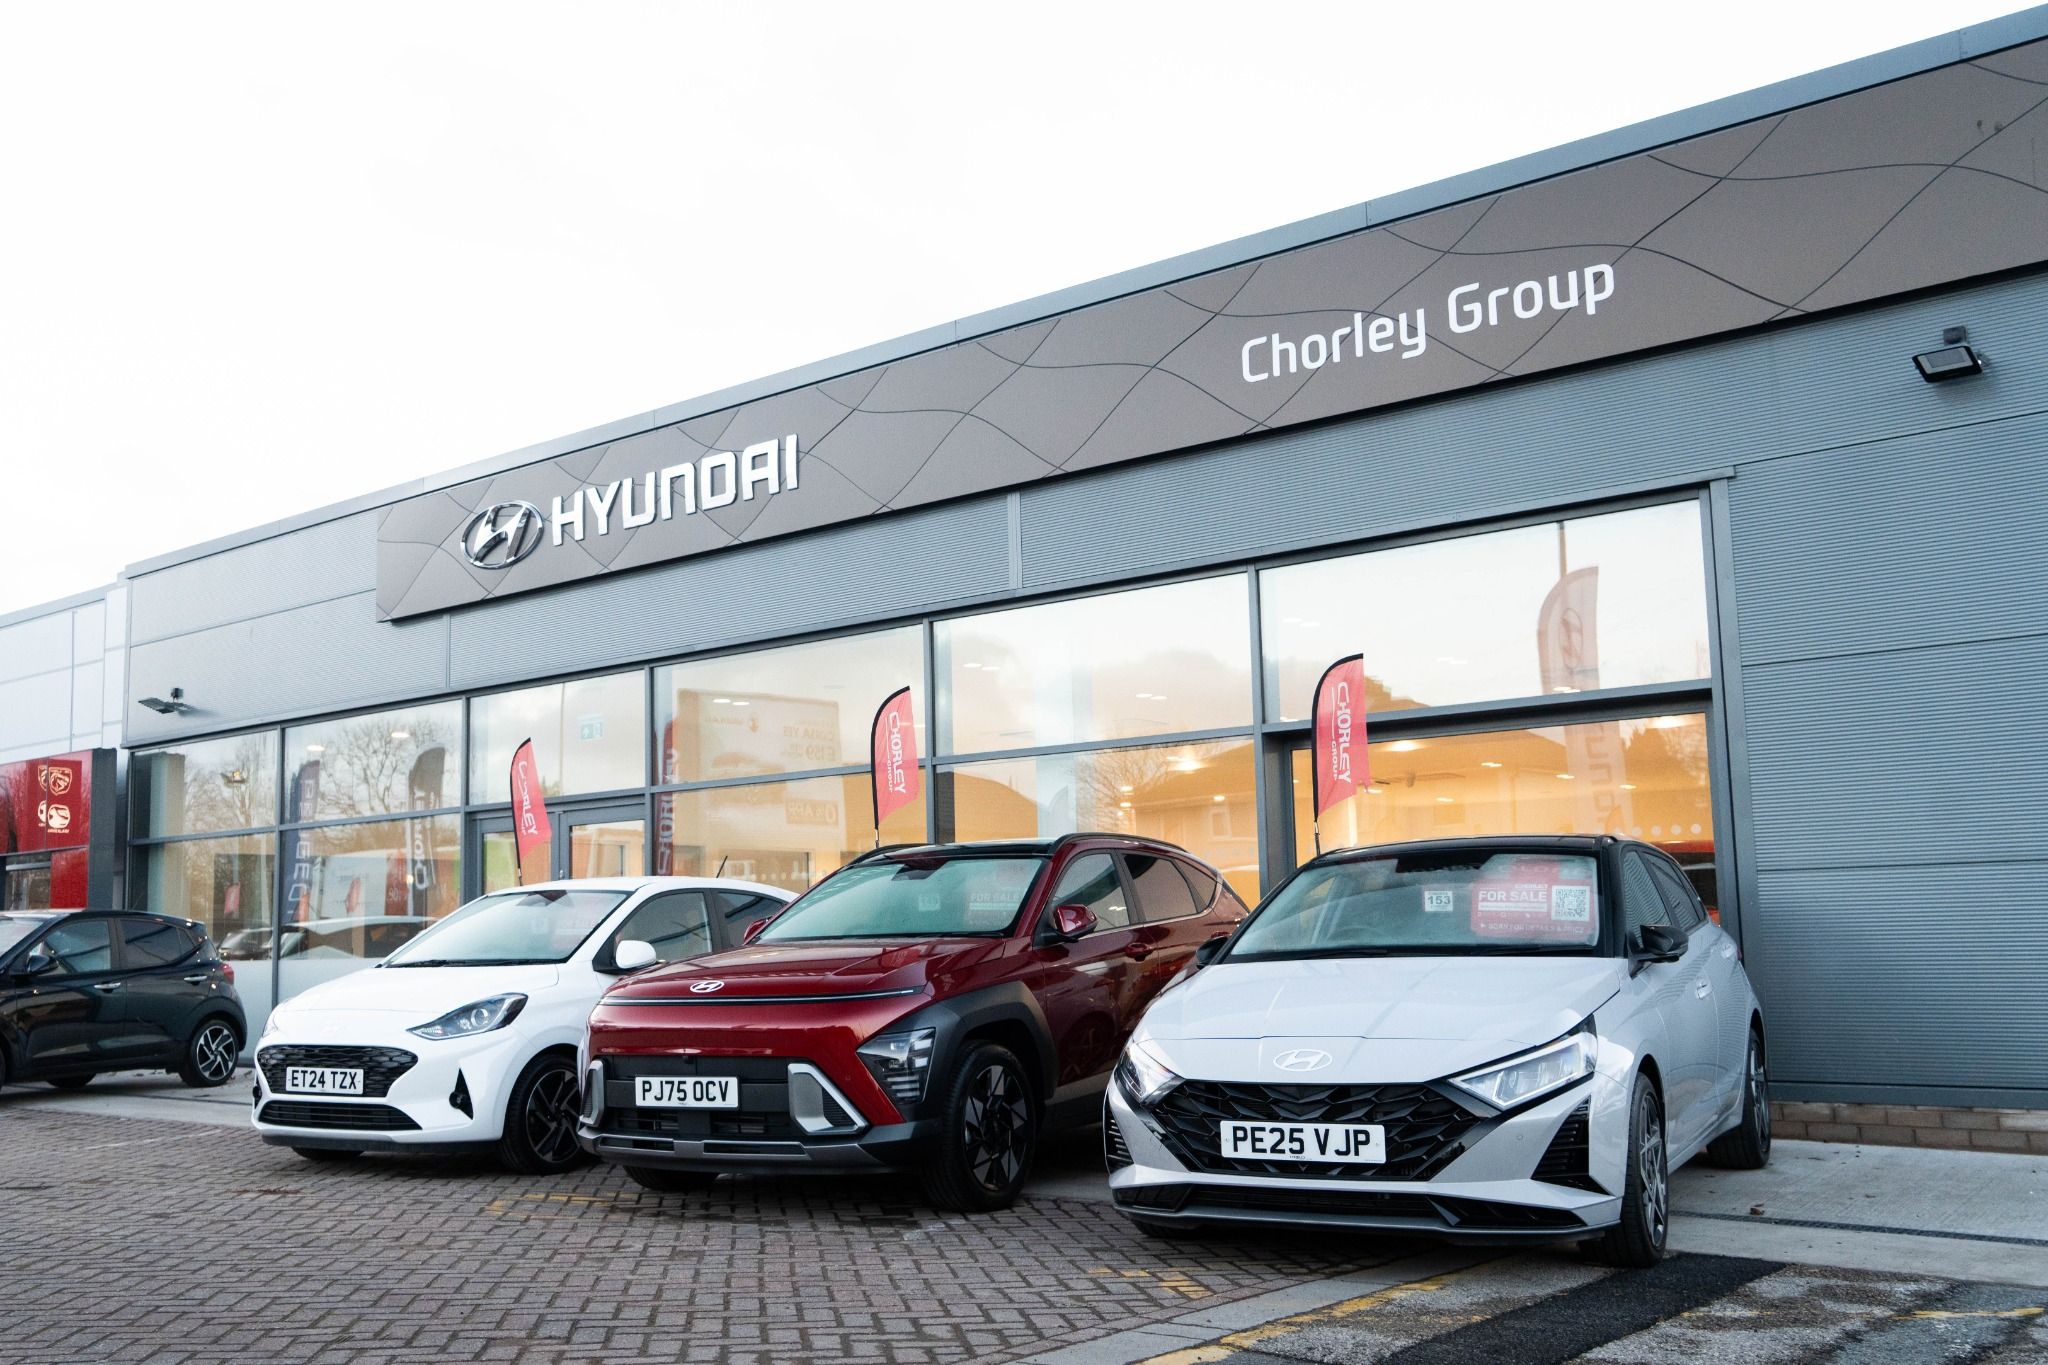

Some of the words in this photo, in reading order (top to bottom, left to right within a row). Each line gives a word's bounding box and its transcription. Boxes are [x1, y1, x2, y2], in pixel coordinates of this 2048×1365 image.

[1241, 311, 1427, 384] Chorley
[1447, 263, 1615, 334] Group
[552, 433, 799, 546] HYUNDAI
[888, 711, 906, 794] CHORLEY
[1336, 681, 1352, 783] CHORLEY
[518, 760, 538, 835] CRLEY
[287, 779, 315, 915] PEGEO
[413, 785, 430, 891] CHOREY
[1427, 895, 1451, 905] 153
[1479, 891, 1506, 902] FOR
[1511, 891, 1547, 902] SALE
[291, 1070, 326, 1088] ET24
[331, 1071, 357, 1090] TZX
[642, 1080, 687, 1102] PJ75
[693, 1080, 729, 1102] OCV
[1232, 1125, 1305, 1155] PE25
[1314, 1128, 1371, 1157] VJP
